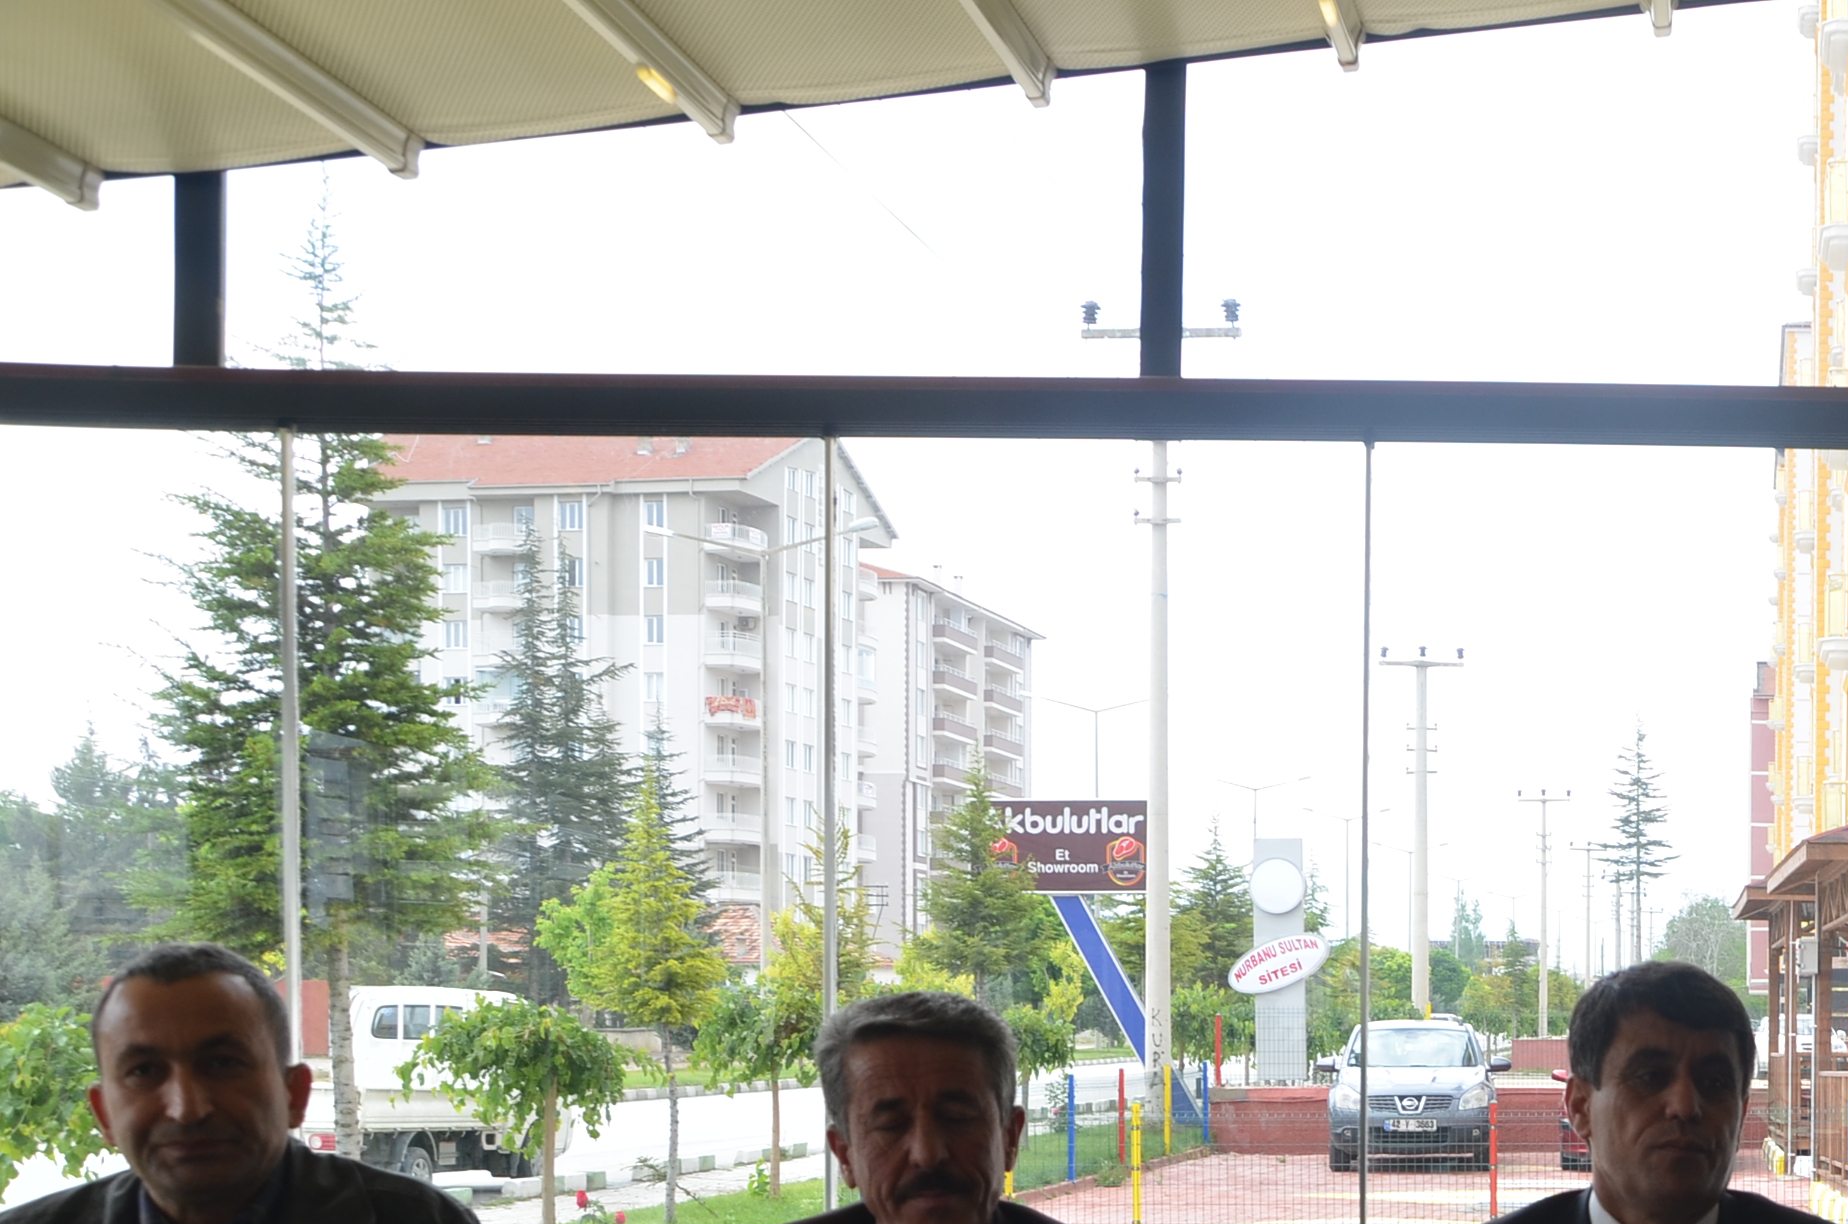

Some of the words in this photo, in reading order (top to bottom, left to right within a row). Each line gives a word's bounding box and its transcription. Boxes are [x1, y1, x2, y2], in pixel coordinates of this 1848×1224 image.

[1055, 848, 1070, 861] Et
[1027, 861, 1099, 874] Showroom
[1234, 944, 1277, 983] NURBANU
[1278, 938, 1319, 954] SULTAN
[1258, 958, 1303, 985] SİTESİ
